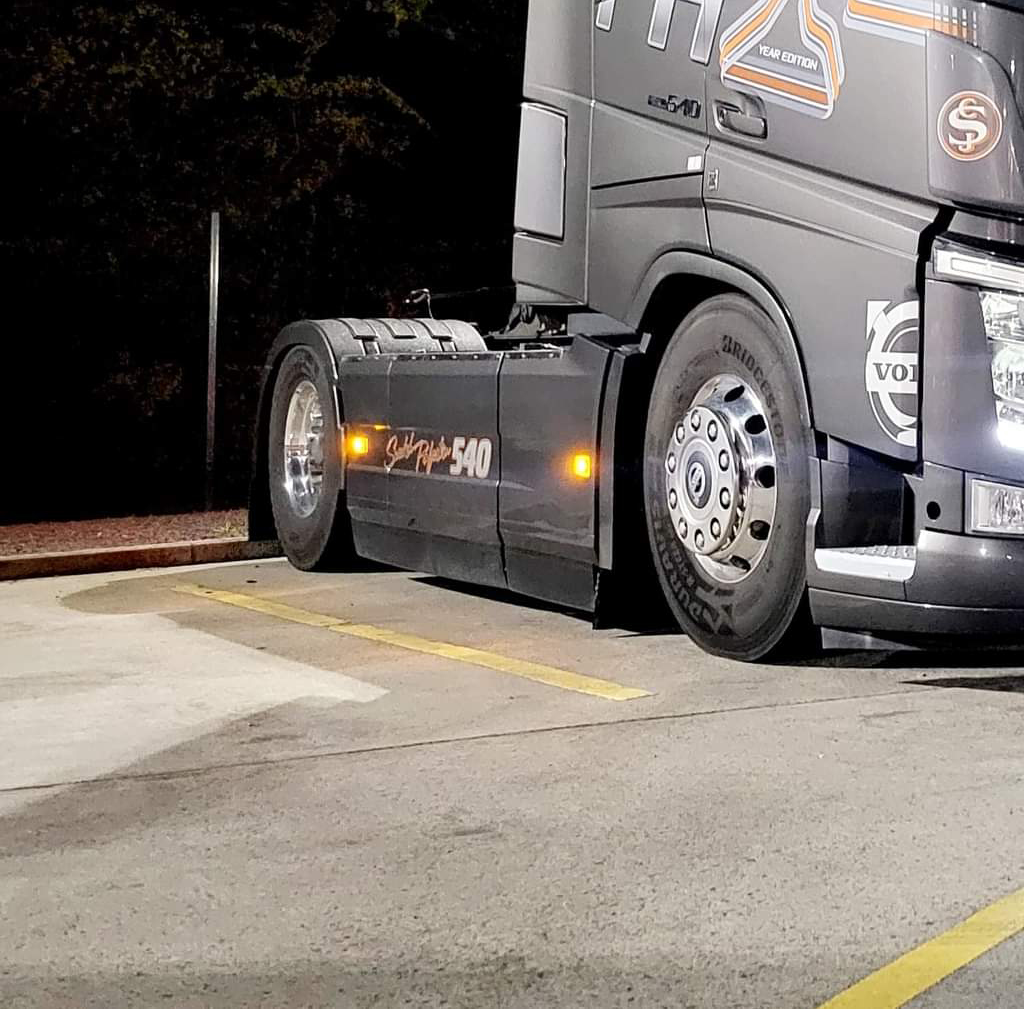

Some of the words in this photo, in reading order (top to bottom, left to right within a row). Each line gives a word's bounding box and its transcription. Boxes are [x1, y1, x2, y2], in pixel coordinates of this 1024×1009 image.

[759, 44, 781, 60] YEAR
[780, 51, 819, 71] EDITION
[448, 436, 492, 479] 540
